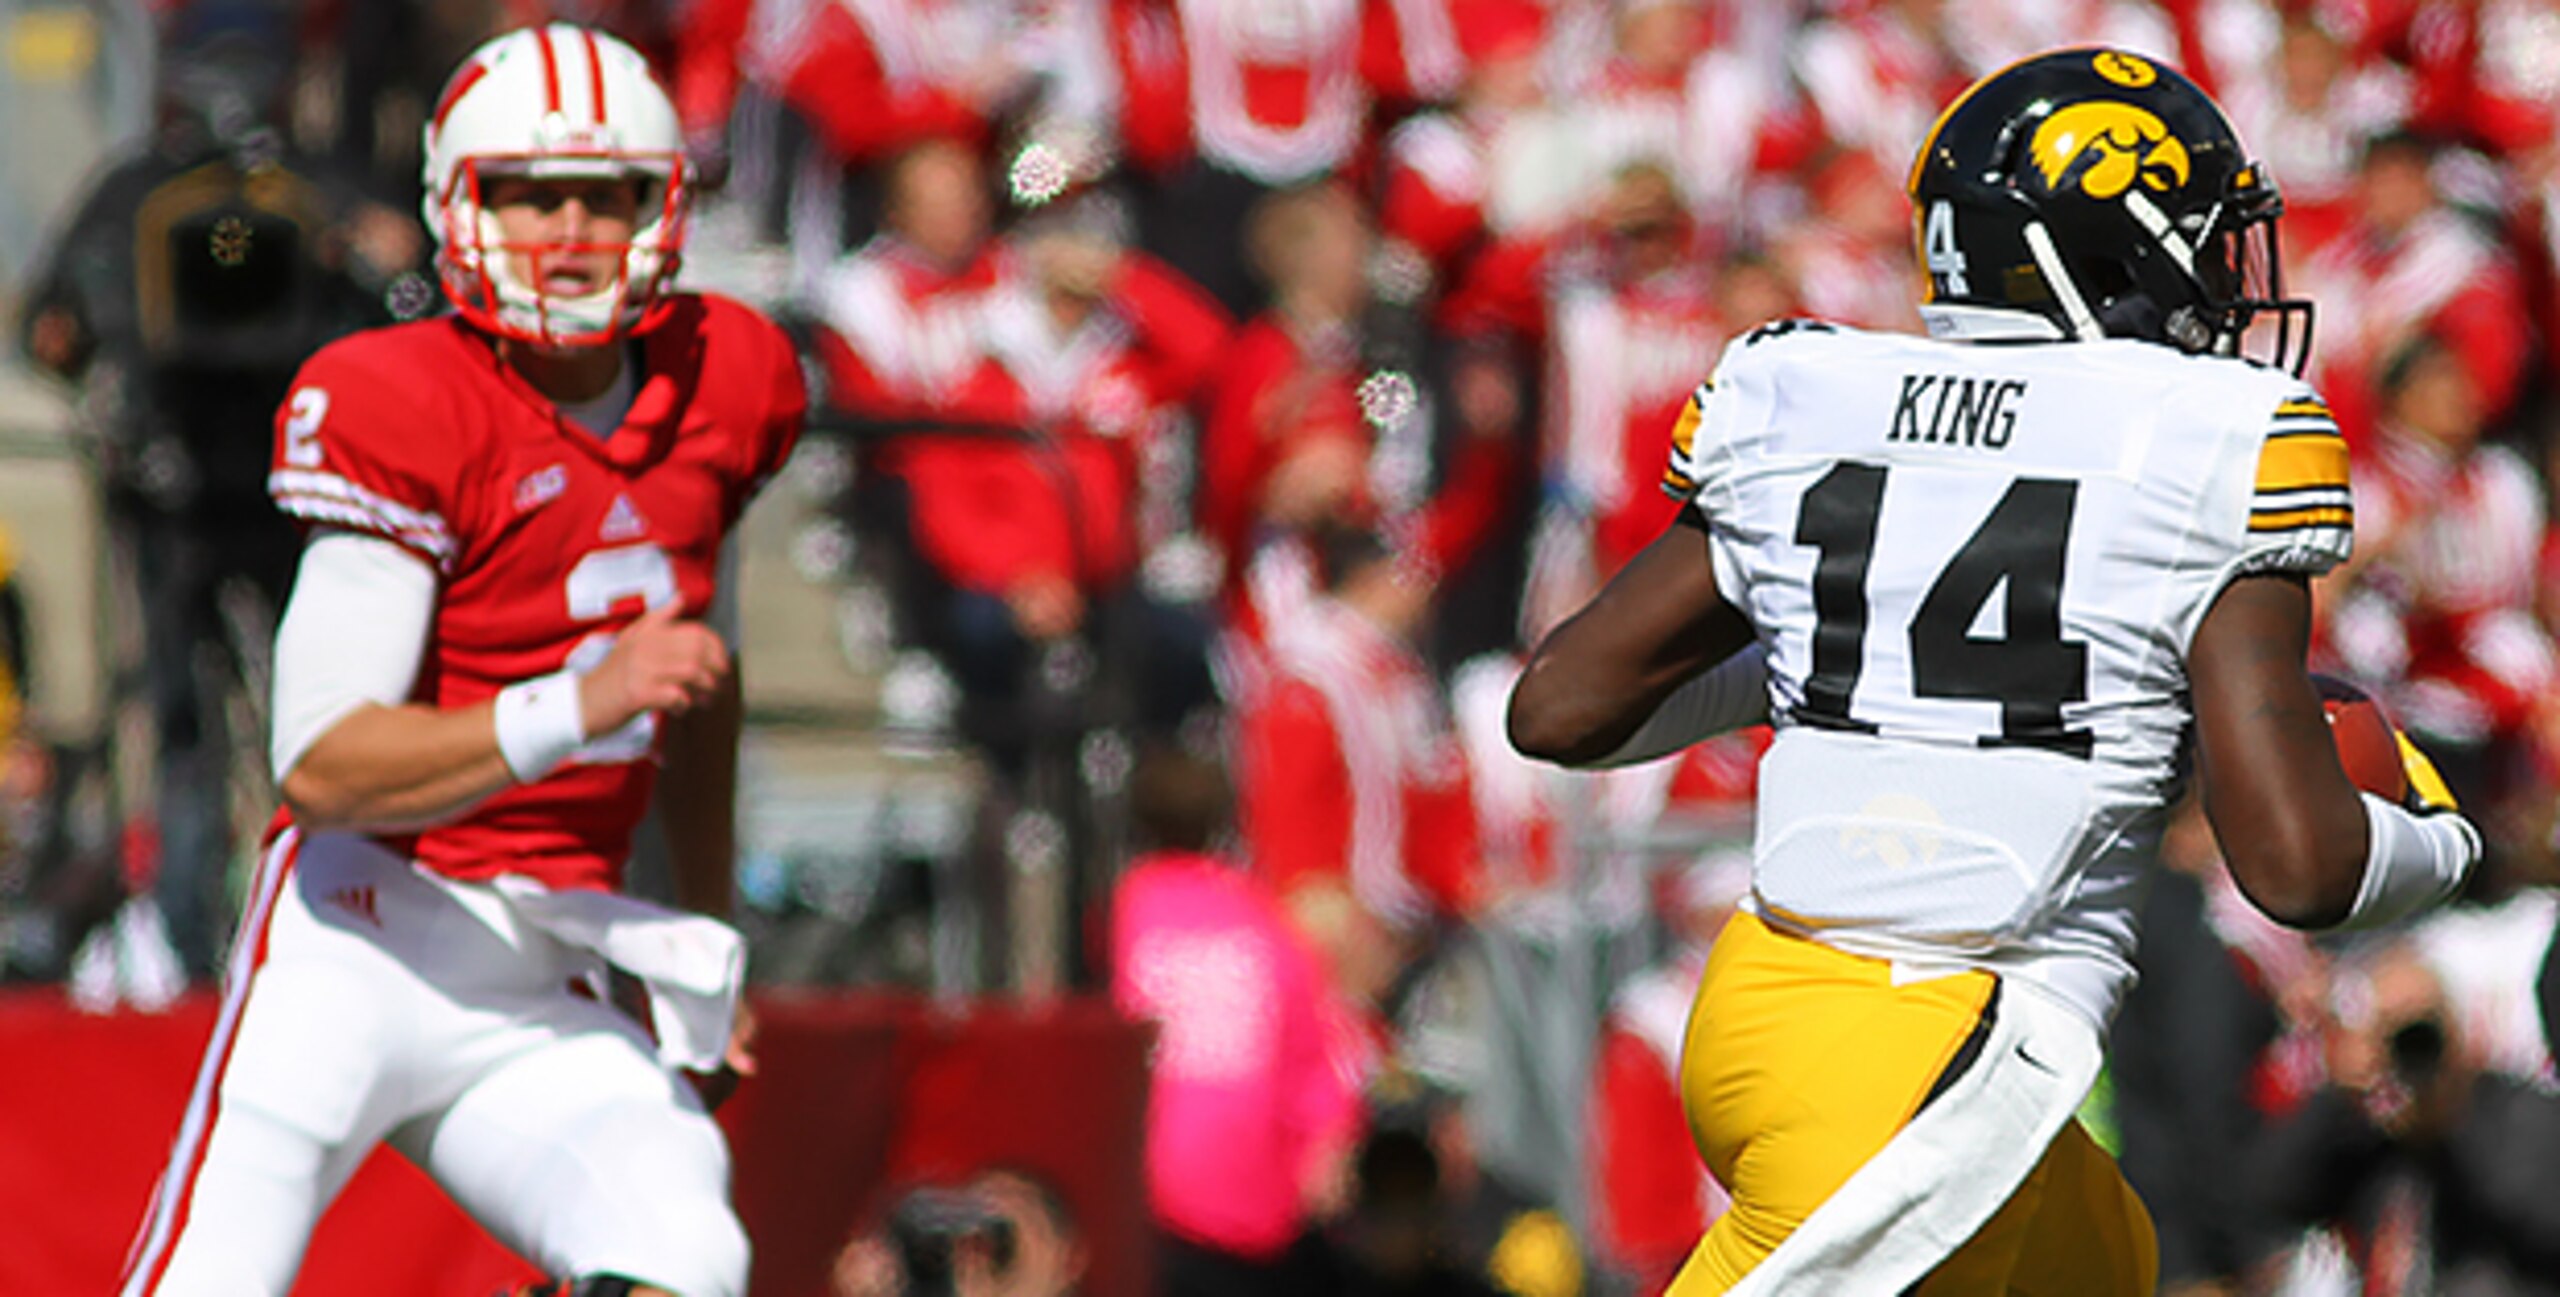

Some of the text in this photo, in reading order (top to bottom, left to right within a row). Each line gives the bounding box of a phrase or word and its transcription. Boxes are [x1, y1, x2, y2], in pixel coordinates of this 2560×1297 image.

[1926, 200, 1970, 295] 4
[286, 388, 329, 466] 2
[1887, 375, 2027, 449] KING
[1794, 460, 2094, 760] 14
